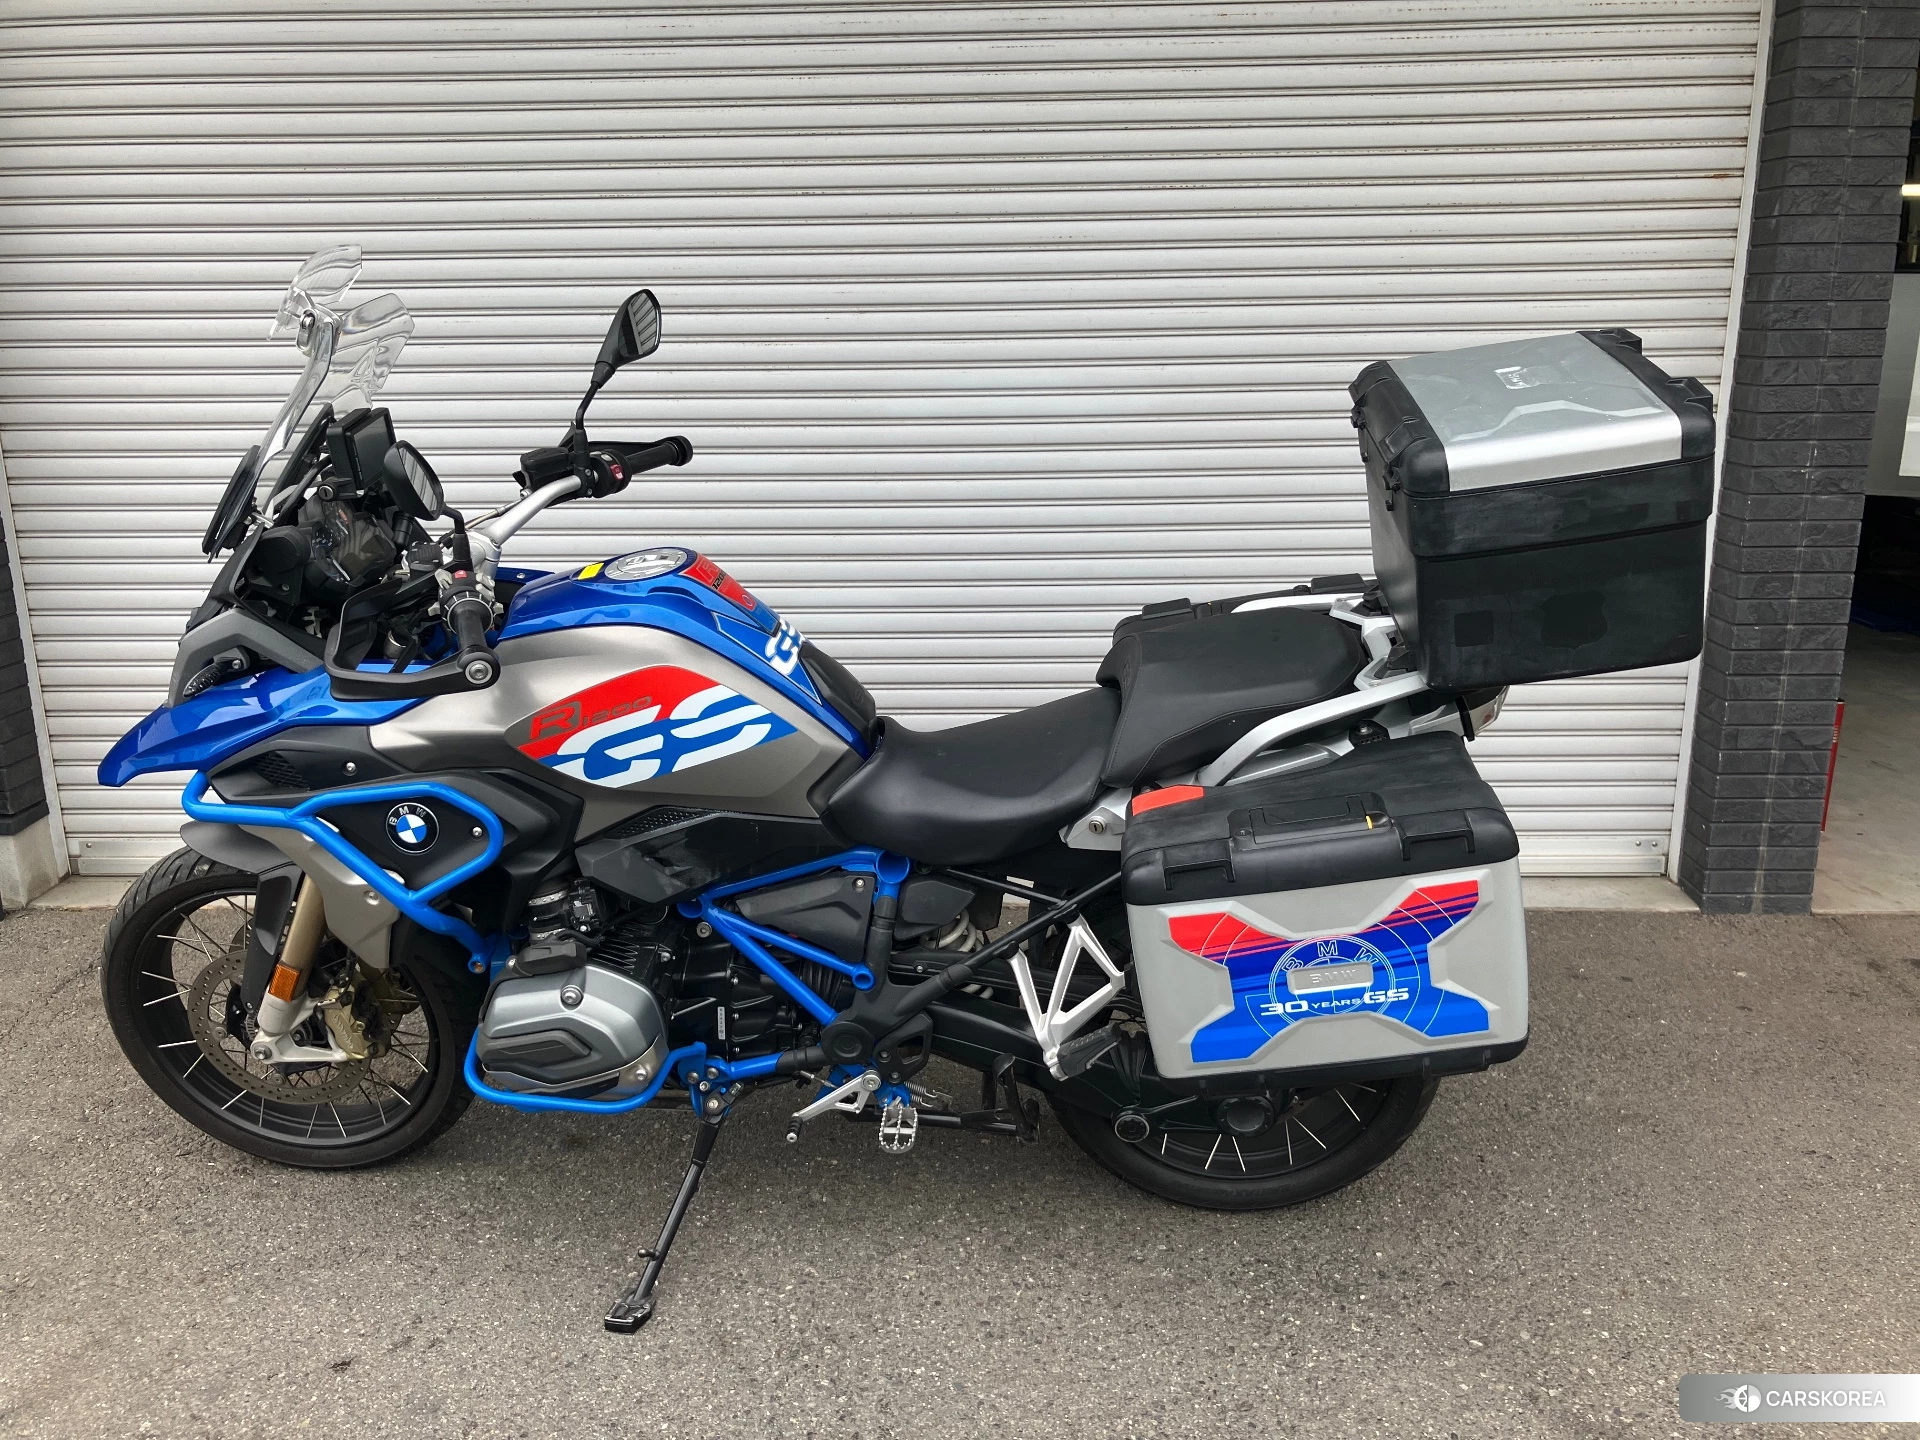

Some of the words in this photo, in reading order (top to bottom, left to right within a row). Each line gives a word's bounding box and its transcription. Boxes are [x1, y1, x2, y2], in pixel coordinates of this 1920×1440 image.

[551, 684, 772, 788] GS
[389, 805, 427, 826] BMW
[1282, 940, 1378, 973] BMW
[1260, 1000, 1309, 1016] 30
[1312, 998, 1361, 1009] YEARS
[1364, 987, 1409, 1005] GS
